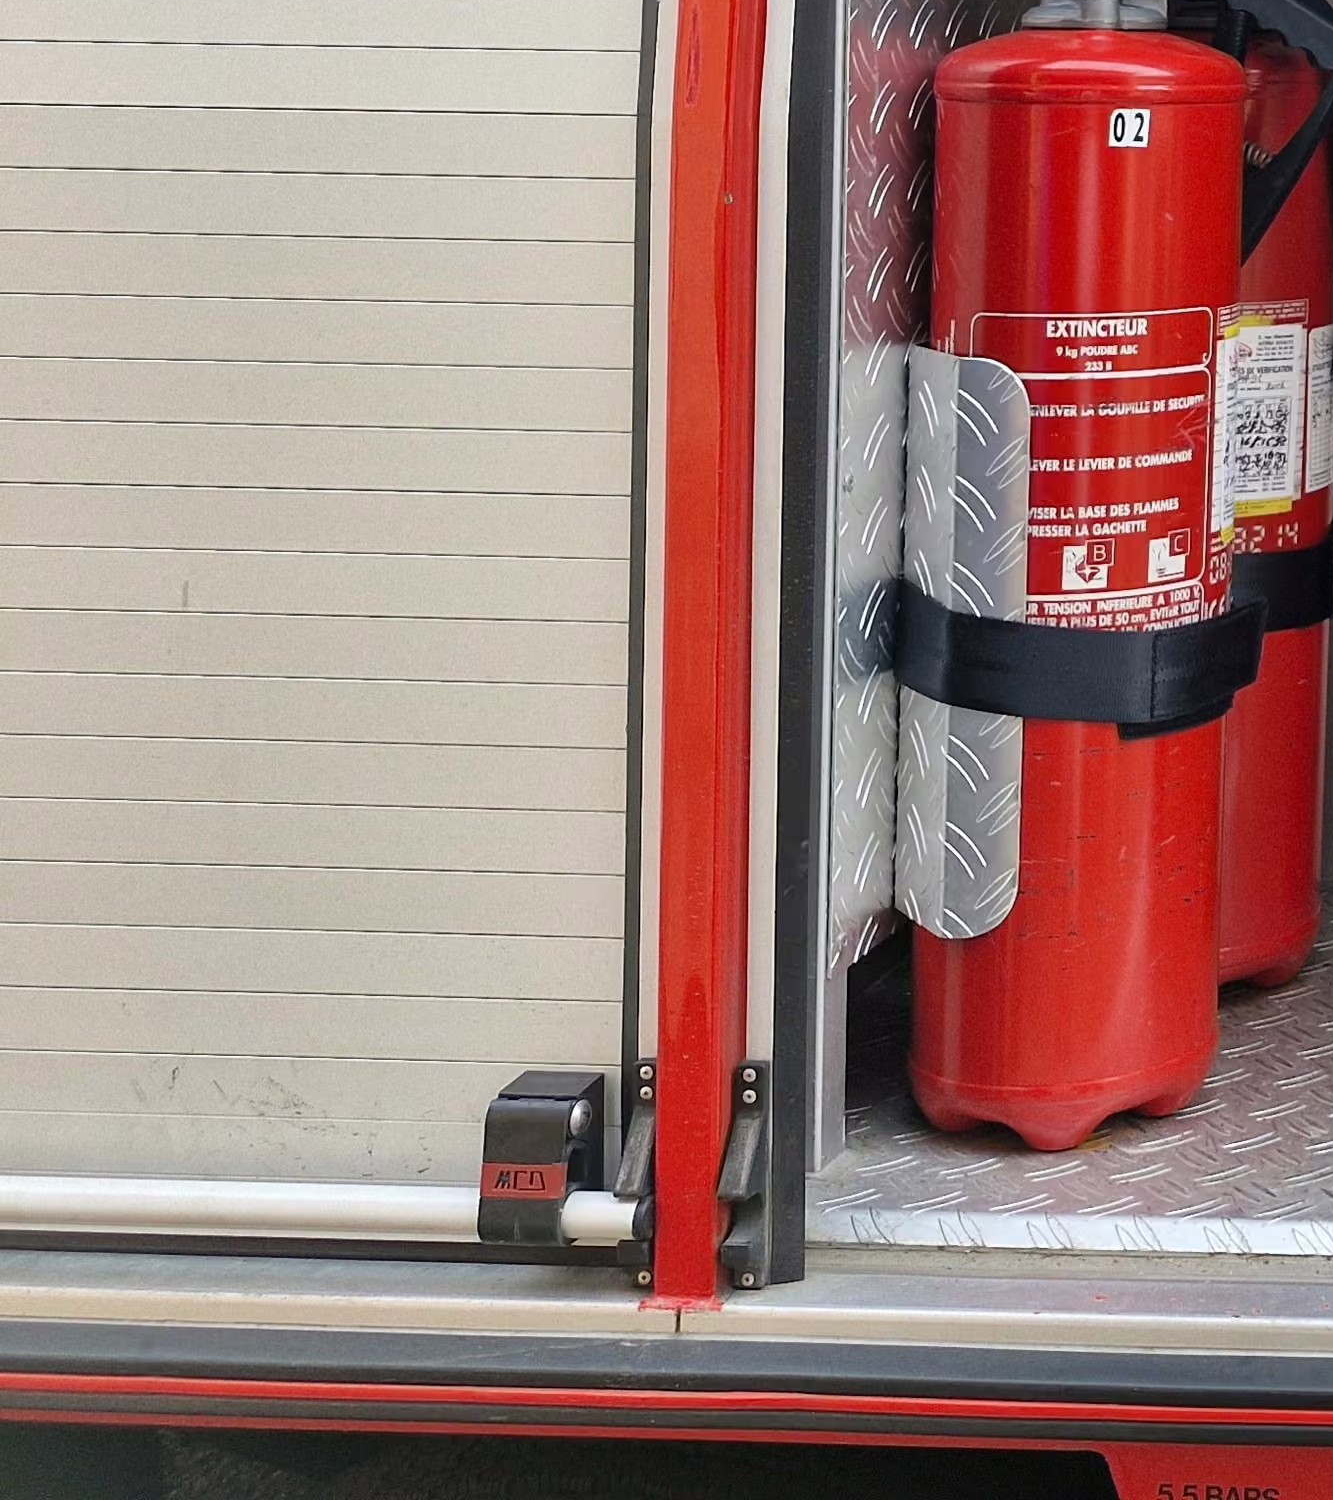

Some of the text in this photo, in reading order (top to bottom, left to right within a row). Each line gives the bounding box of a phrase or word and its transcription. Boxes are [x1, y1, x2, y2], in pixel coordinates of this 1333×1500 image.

[1046, 319, 1147, 338] EXTINCTEUR
[1056, 344, 1138, 358] 9 kg POUDRE ABC
[1153, 399, 1166, 412] DE
[1064, 459, 1075, 470] LE
[1079, 457, 1115, 470] LEVIER
[1118, 456, 1132, 468] DE
[1135, 449, 1193, 467] COMMANDE
[1061, 507, 1075, 519] LA
[1078, 505, 1107, 518] BASE
[1110, 504, 1131, 516] DES
[1134, 497, 1180, 514] FLAMMES
[1076, 524, 1089, 536] LA
[1093, 520, 1147, 535] GACHETTE
[1174, 535, 1184, 552] C
[1093, 545, 1107, 562] B
[1044, 601, 1092, 615] TENSION
[1097, 595, 1153, 613] INFERIEURE
[1157, 594, 1165, 606] A
[1099, 614, 1113, 627] DE
[1115, 612, 1129, 625] 50
[1182, 600, 1200, 613] TOUT
